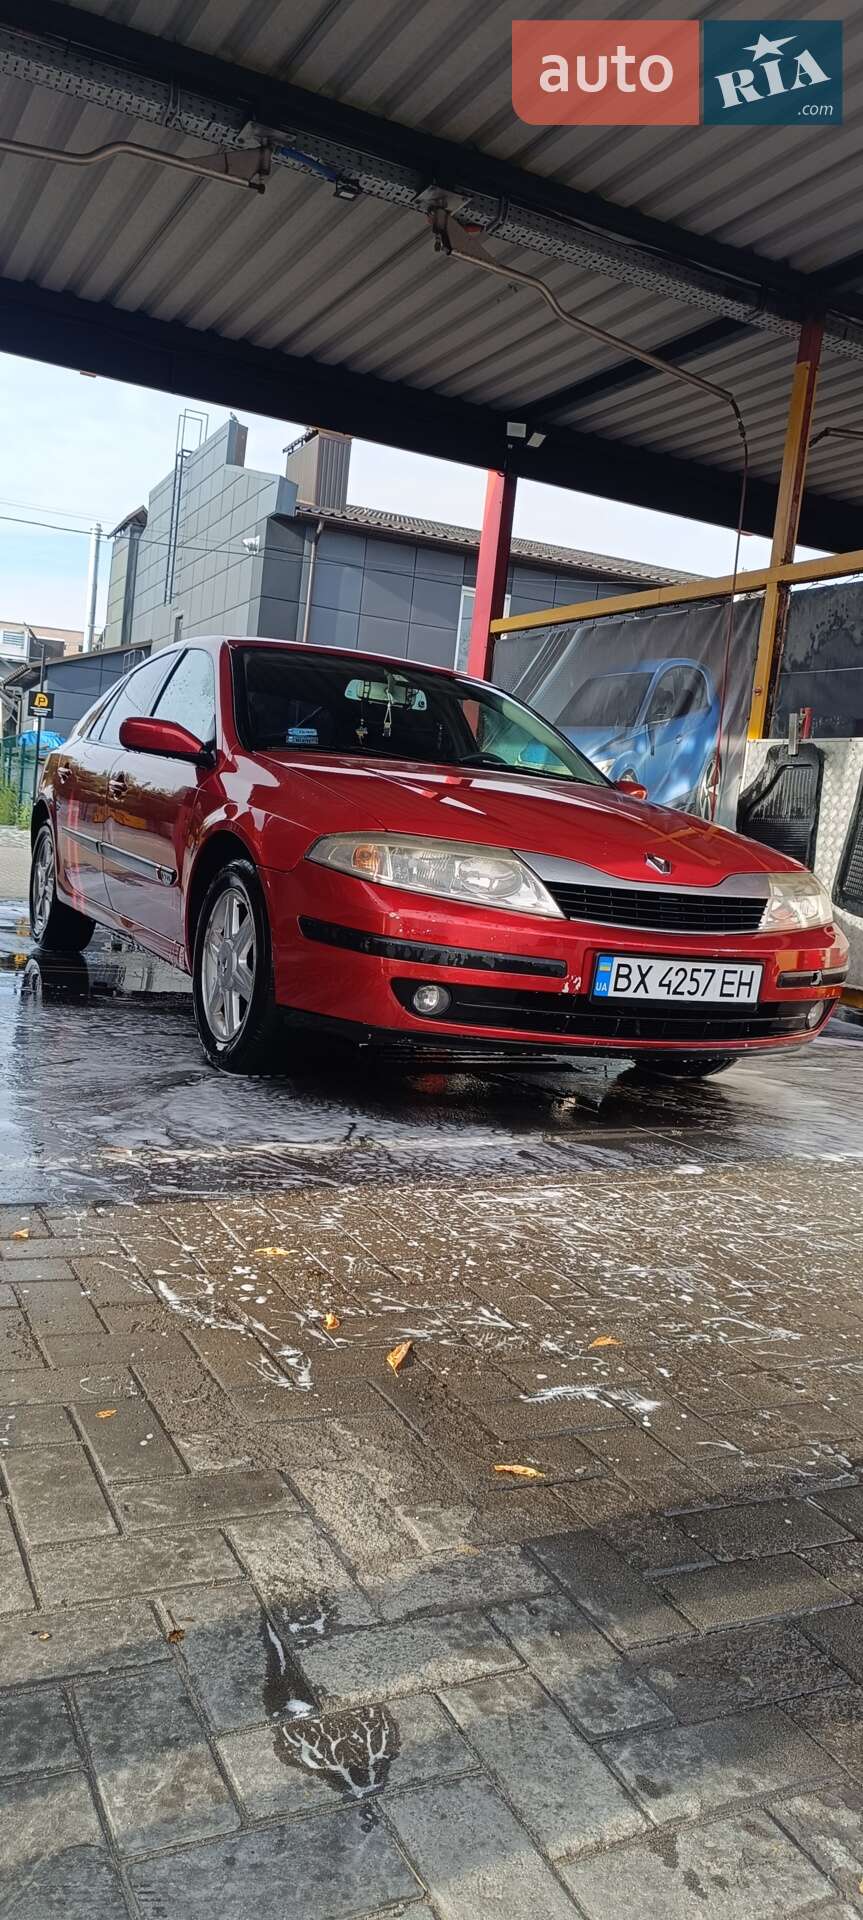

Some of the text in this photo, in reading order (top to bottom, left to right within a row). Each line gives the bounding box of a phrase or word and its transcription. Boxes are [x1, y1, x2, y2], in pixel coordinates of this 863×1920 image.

[595, 982, 607, 992] UA
[612, 963, 755, 998] BX 4257 EH
